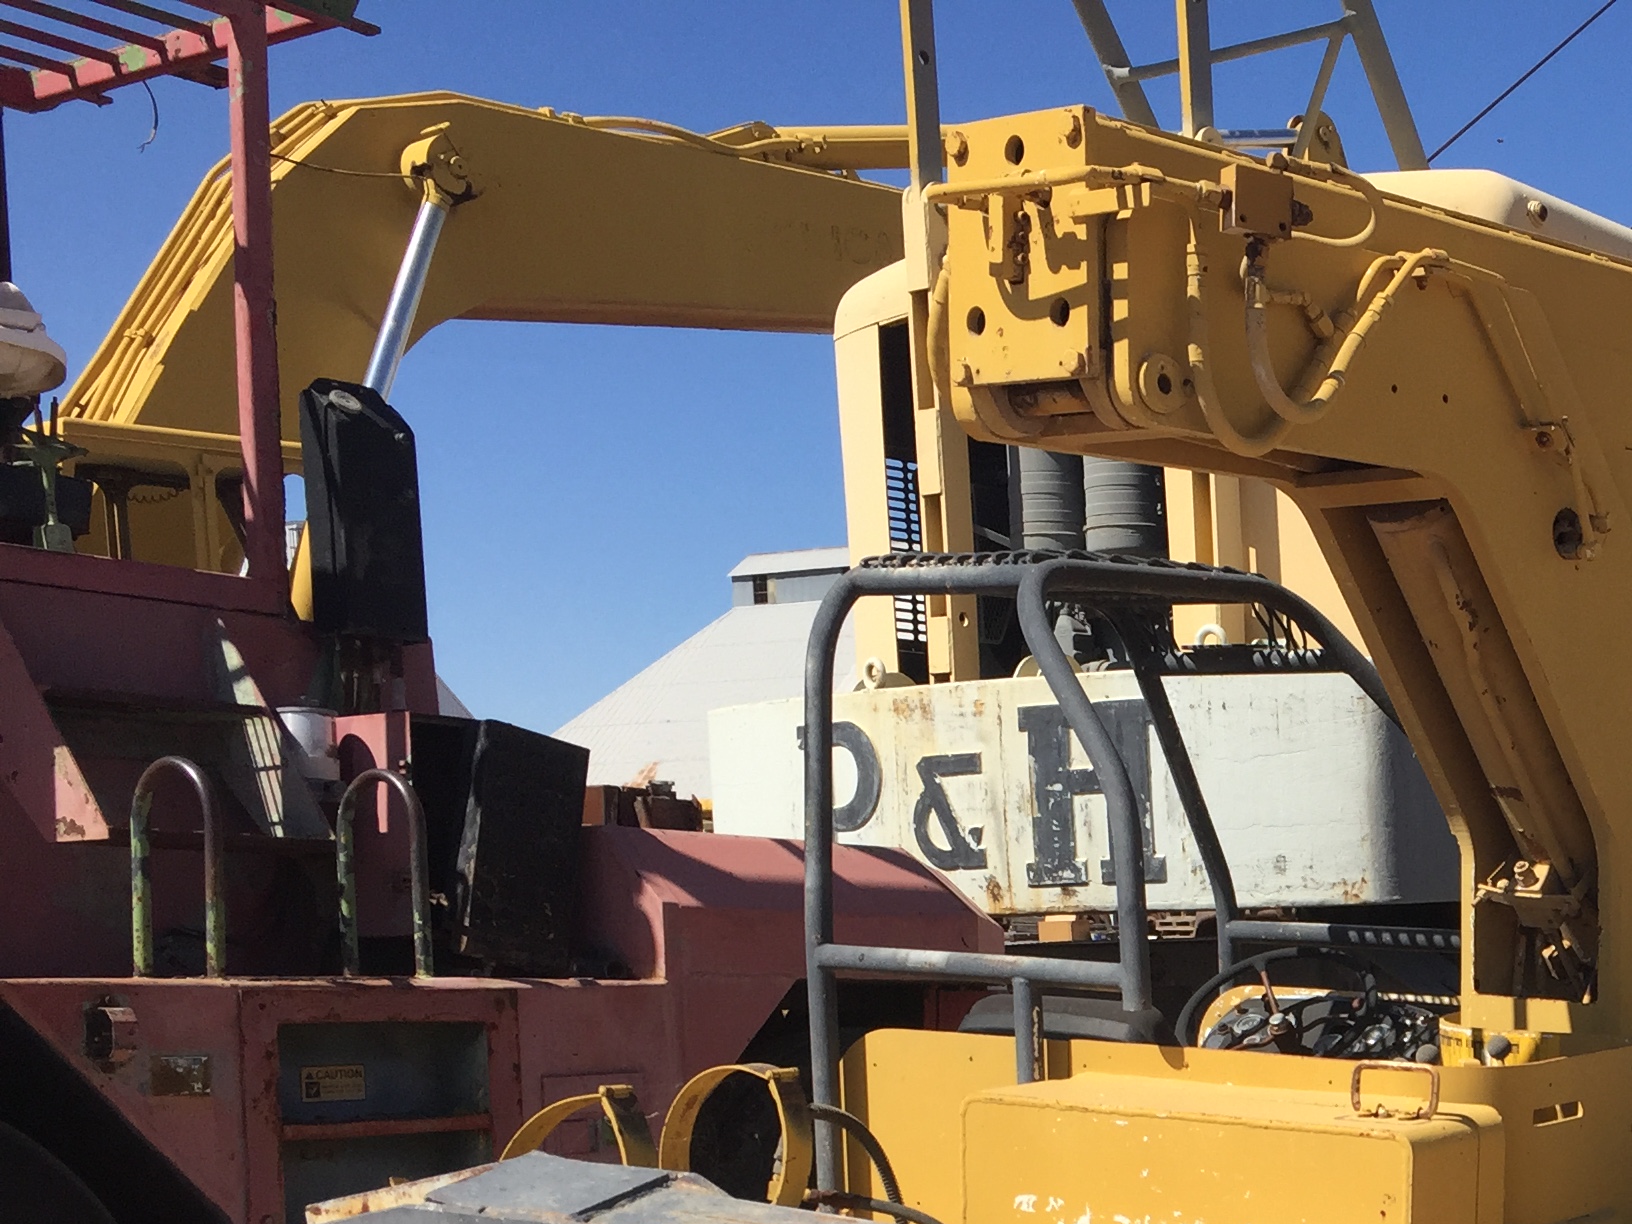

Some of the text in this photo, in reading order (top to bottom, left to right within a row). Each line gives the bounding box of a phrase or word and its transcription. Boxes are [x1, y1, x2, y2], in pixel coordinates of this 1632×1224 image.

[914, 752, 987, 870] &
[1018, 698, 1167, 887] H
[316, 1069, 362, 1079] CAUTION
